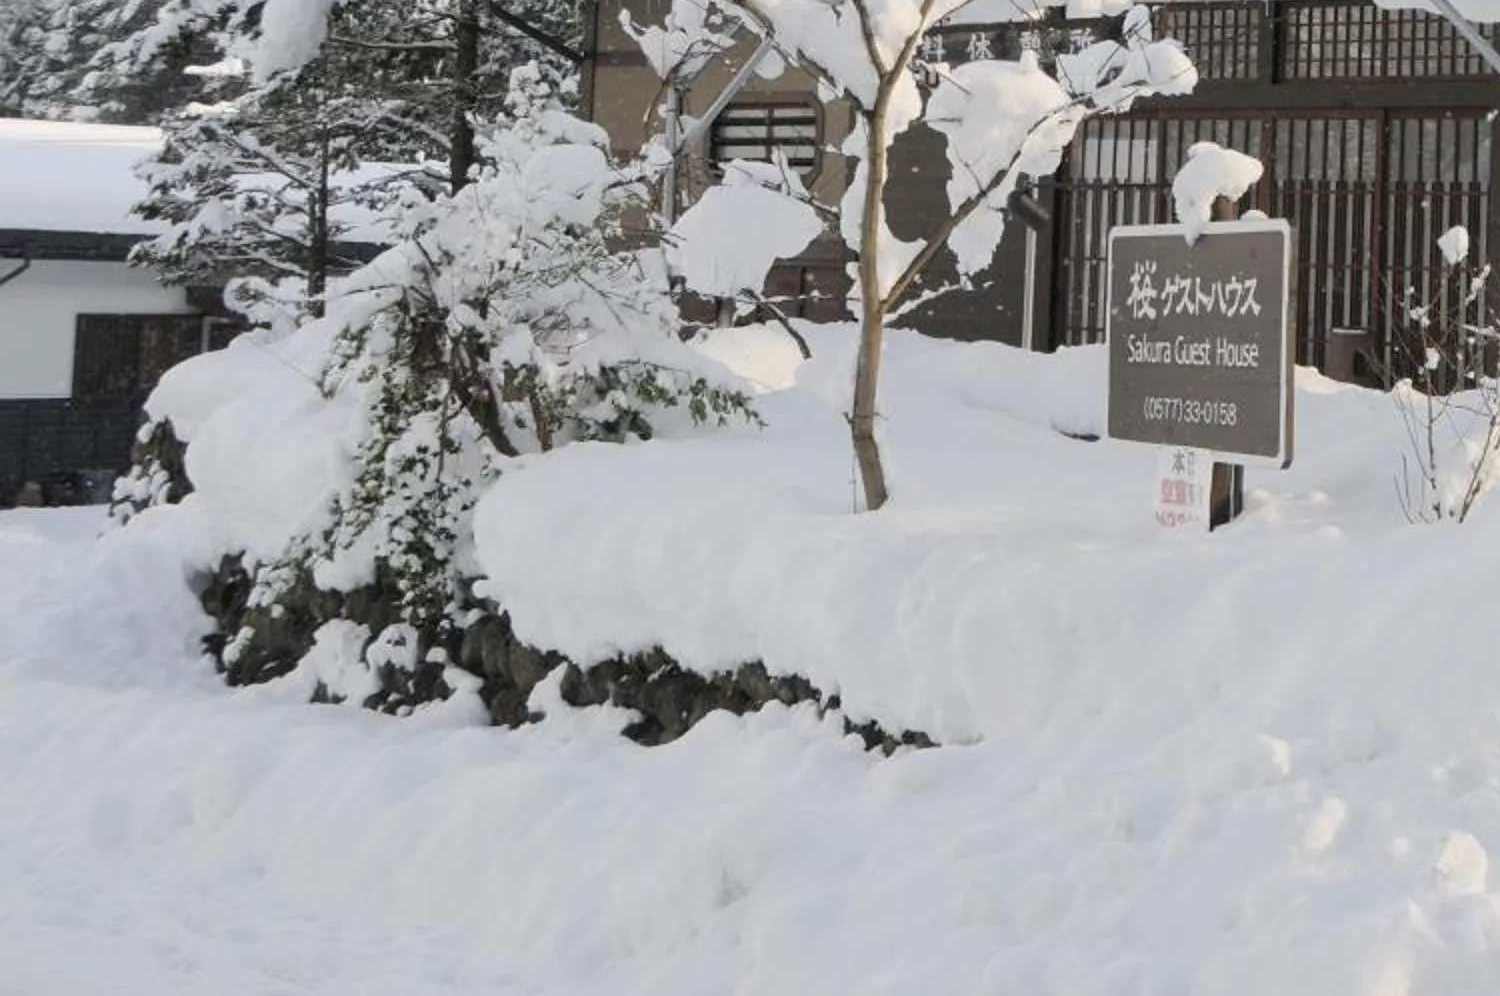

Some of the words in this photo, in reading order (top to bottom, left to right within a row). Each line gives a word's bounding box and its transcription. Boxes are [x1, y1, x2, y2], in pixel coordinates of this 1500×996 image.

[1127, 333, 1172, 364] Sakura
[1174, 335, 1212, 366] Guest
[1215, 336, 1260, 368] House
